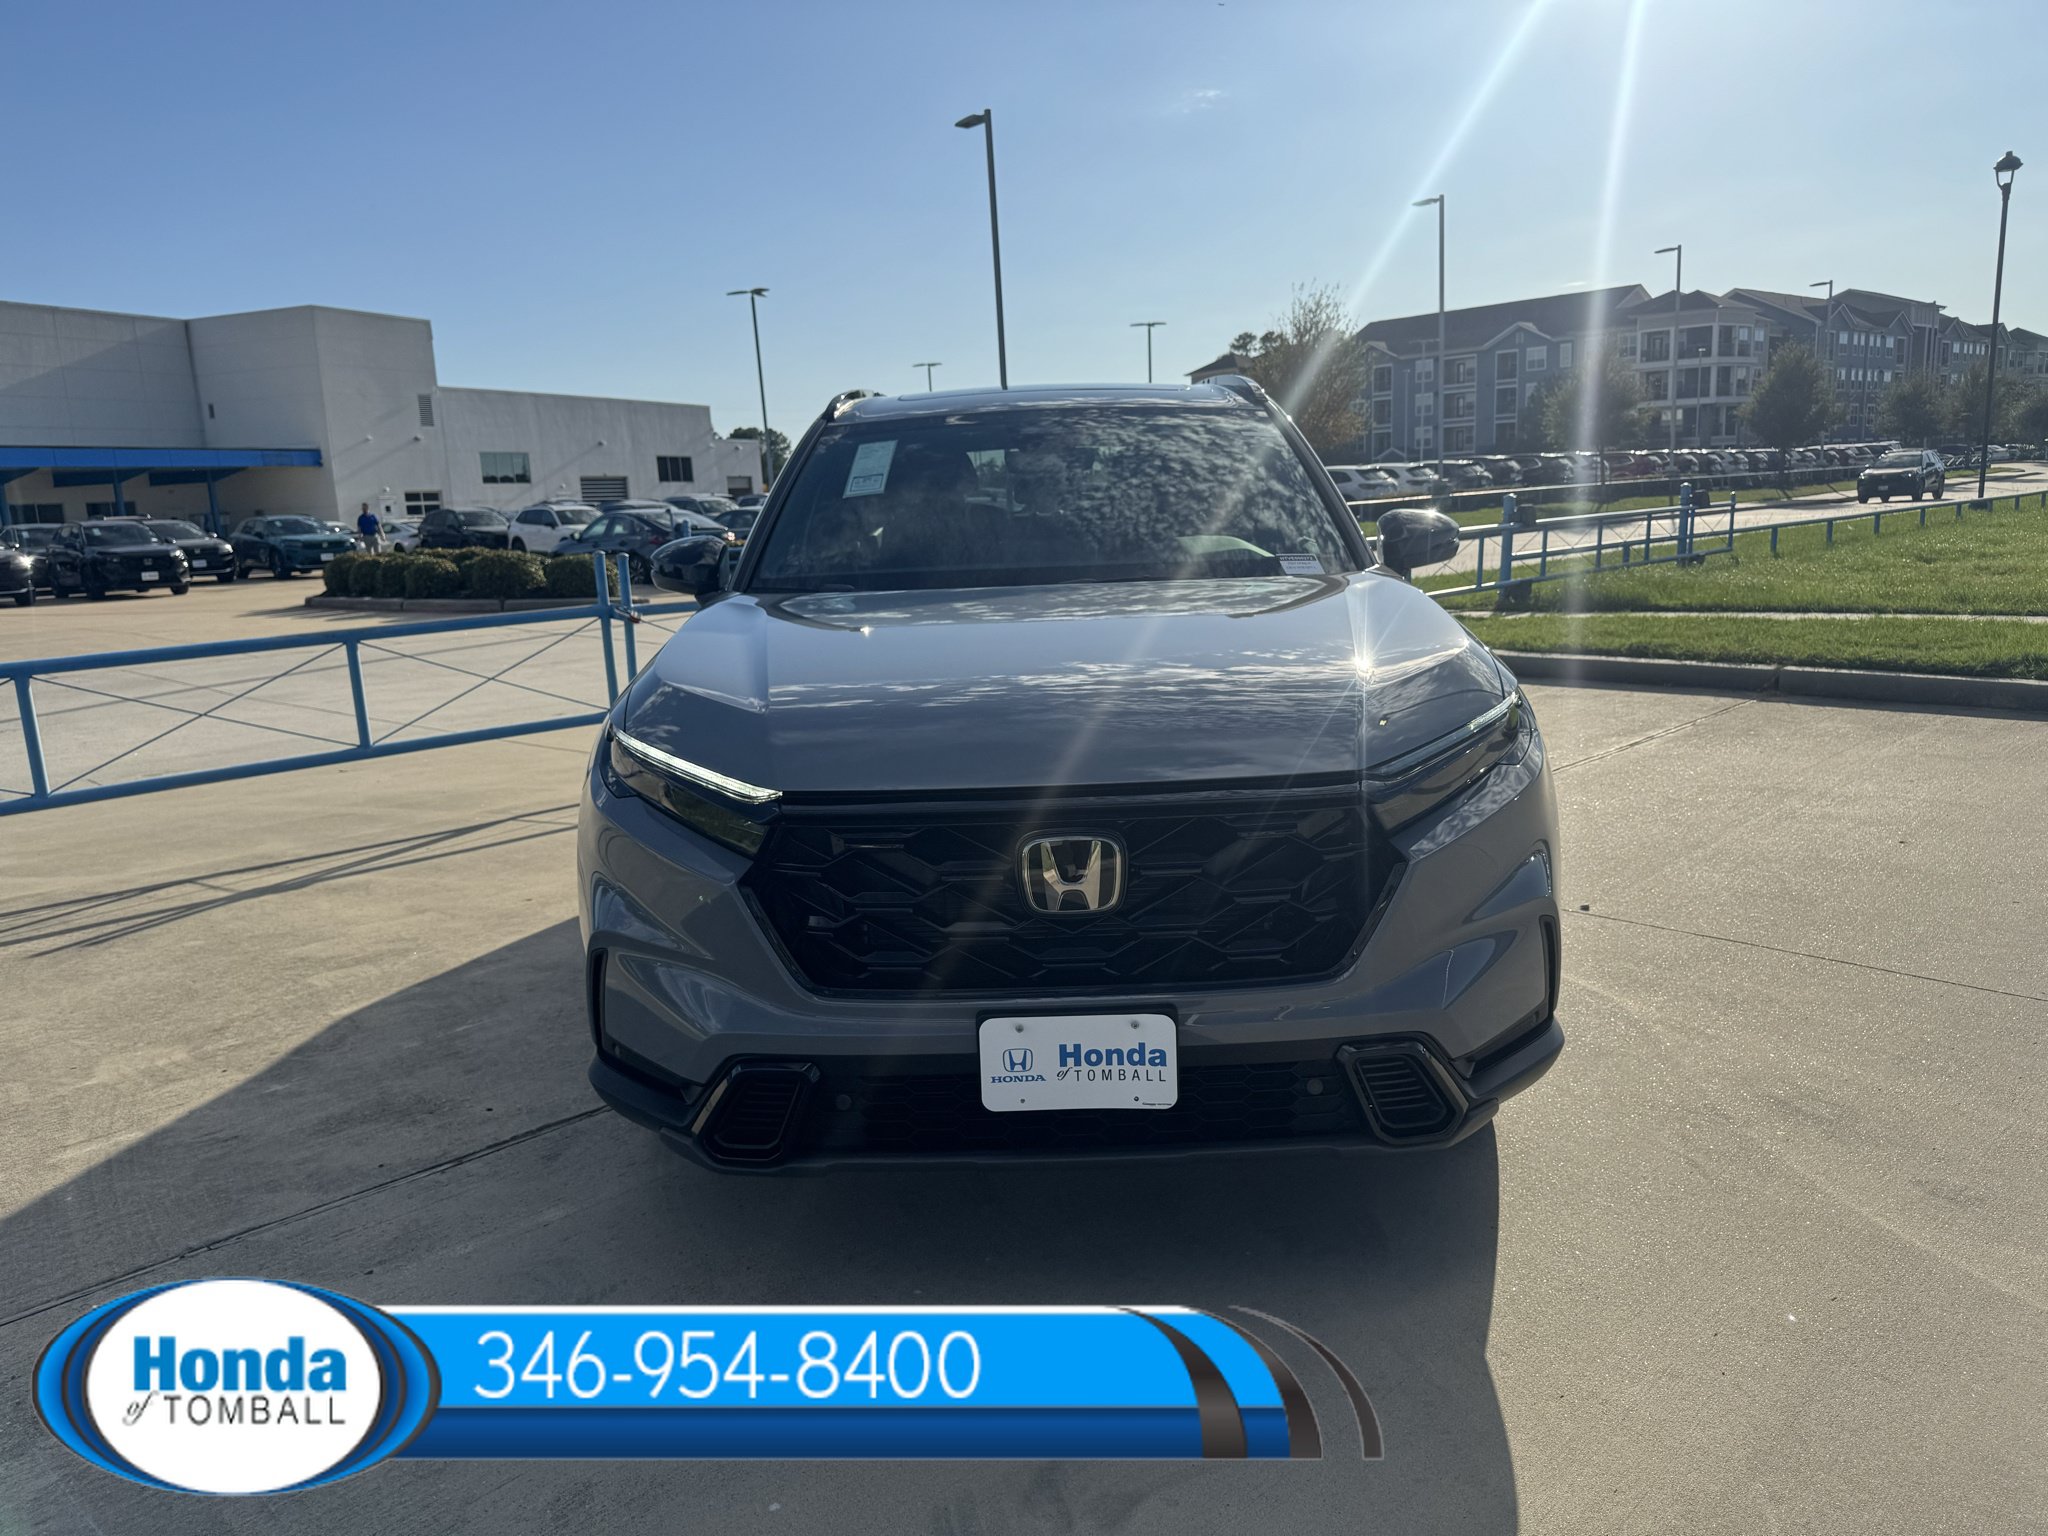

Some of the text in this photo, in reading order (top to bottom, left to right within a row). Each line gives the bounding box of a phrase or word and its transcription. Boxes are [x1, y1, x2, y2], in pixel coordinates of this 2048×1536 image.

[1058, 1042, 1168, 1068] Honda
[990, 1074, 1047, 1084] HONDA
[1056, 1066, 1167, 1083] of TOMBALL
